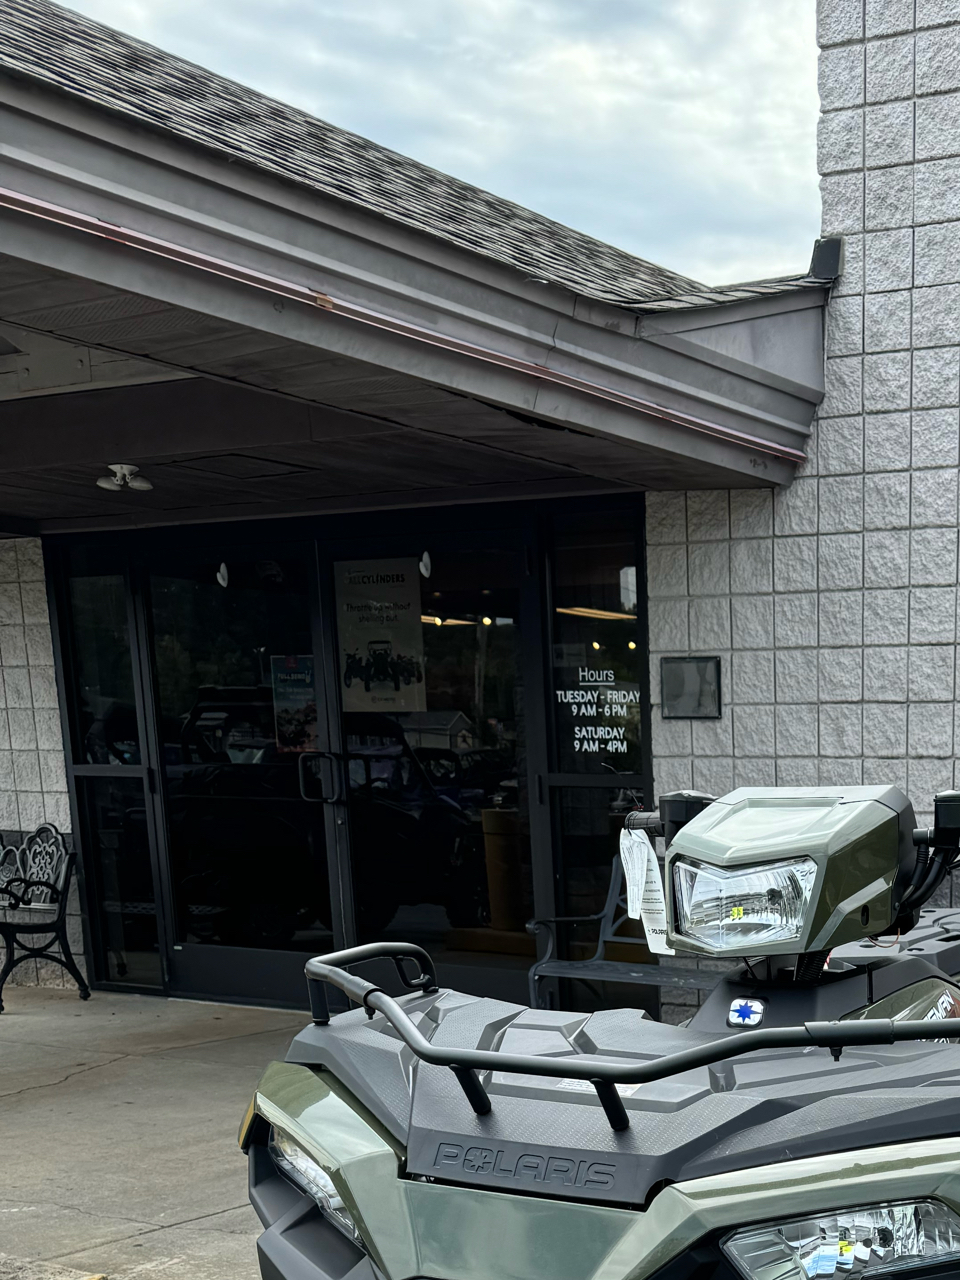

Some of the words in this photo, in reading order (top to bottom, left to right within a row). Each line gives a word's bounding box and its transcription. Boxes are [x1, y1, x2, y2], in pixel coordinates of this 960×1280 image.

[385, 602, 411, 611] without
[578, 667, 615, 681] Hours
[556, 690, 599, 703] TUESDAY
[607, 690, 640, 703] FRIDAY
[571, 704, 578, 717] 9
[580, 704, 597, 717] AM
[604, 704, 611, 717] 6
[612, 704, 627, 717] PM
[574, 726, 625, 739] SATURDAY
[573, 741, 580, 752] 9
[582, 741, 599, 753] AM
[606, 741, 628, 753] 4PM
[433, 1142, 617, 1191] POLARIS
